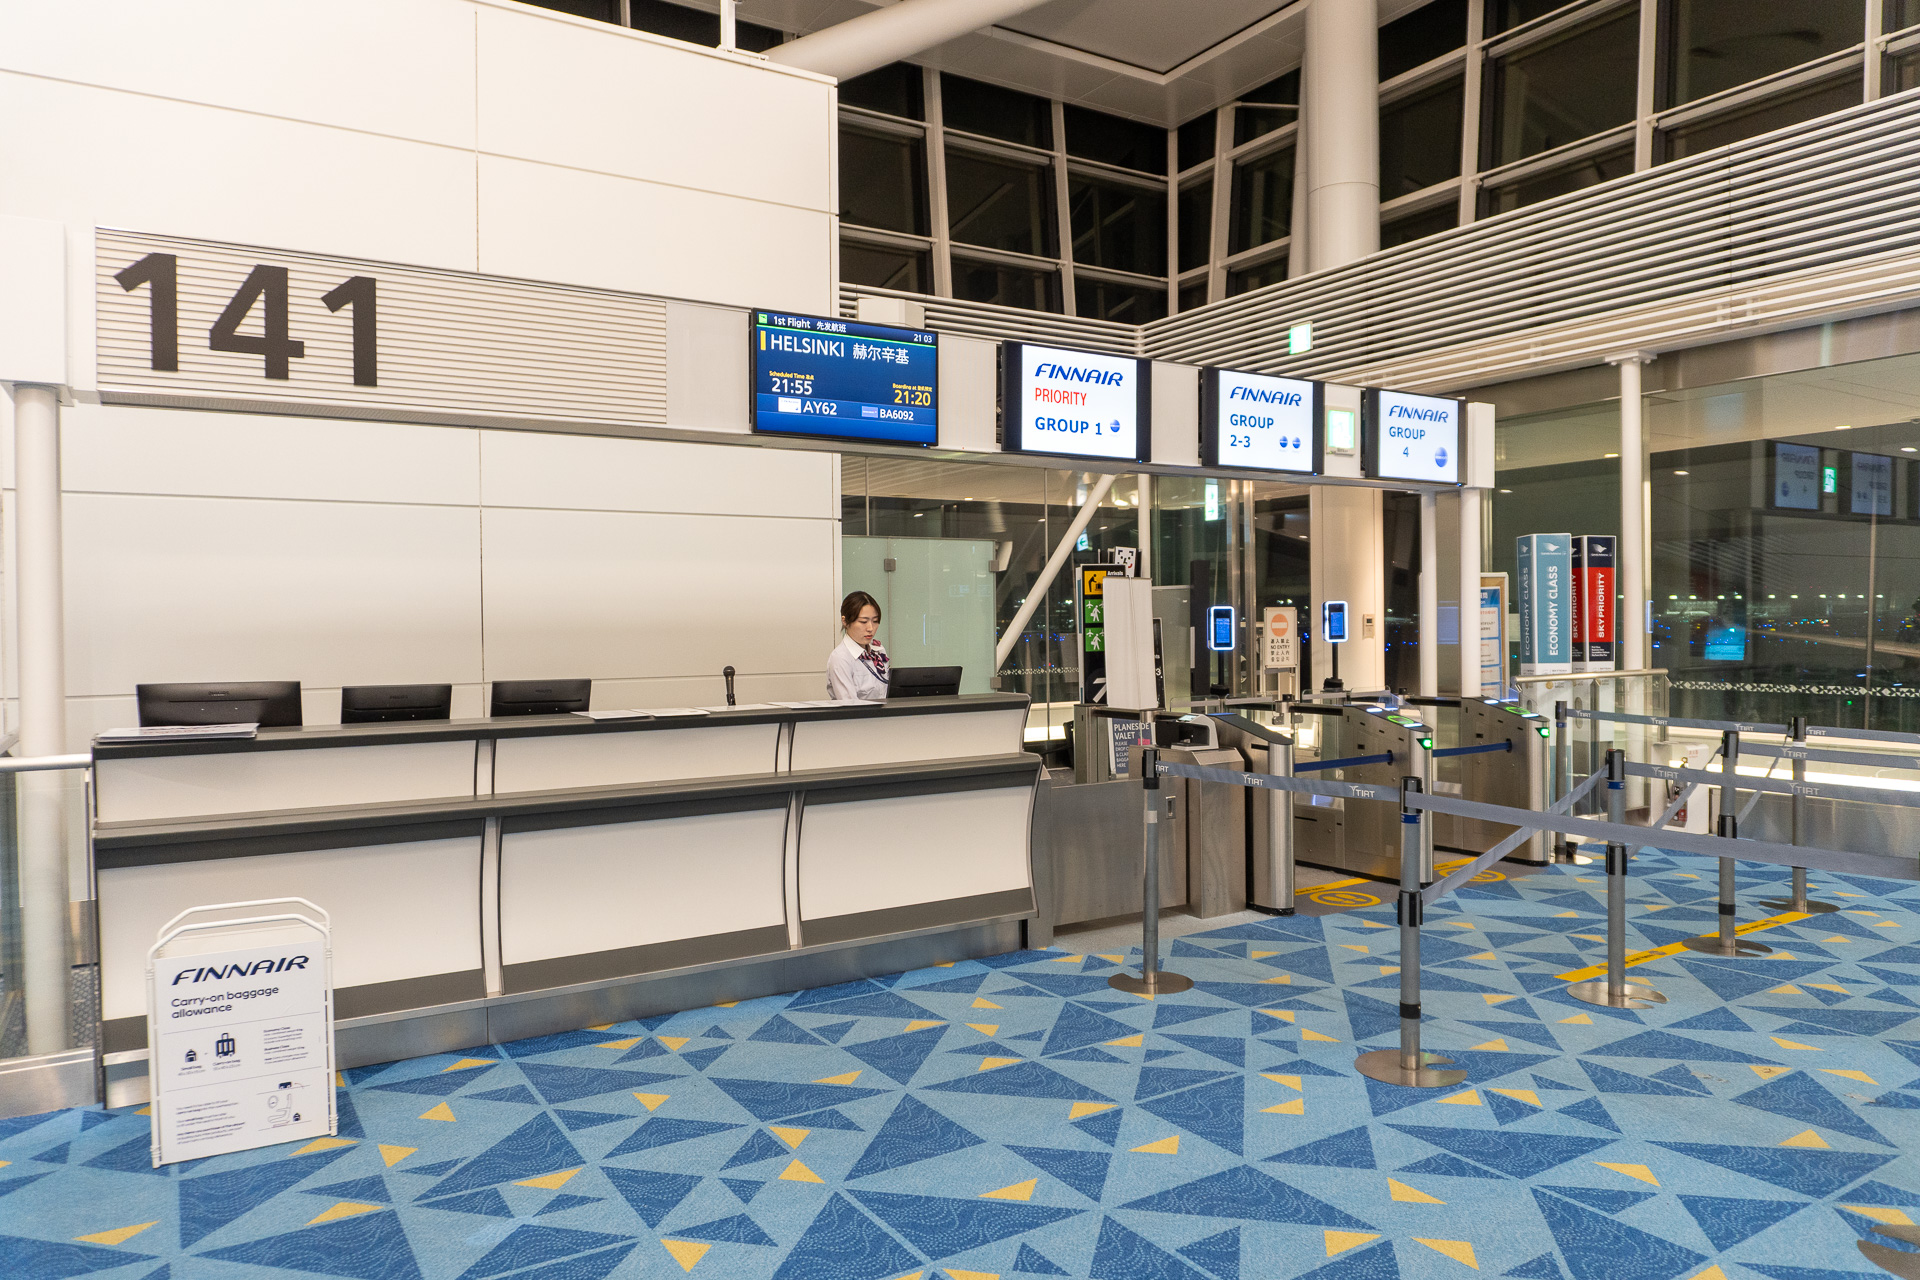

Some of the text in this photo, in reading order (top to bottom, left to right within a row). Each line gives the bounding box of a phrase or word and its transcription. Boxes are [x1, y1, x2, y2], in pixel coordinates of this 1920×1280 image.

[113, 252, 377, 388] 141
[773, 315, 811, 329] 1st Flight
[771, 334, 845, 357] HELSINKI
[913, 333, 933, 343] 21 03
[852, 342, 910, 365] 赫尔辛基
[769, 370, 793, 379] Scheduled
[1034, 363, 1124, 387] FINNAIR
[771, 377, 813, 396] 21:55
[894, 389, 932, 407] 21:20
[1034, 387, 1088, 406] PRIORITY
[1230, 386, 1302, 407] FINNAIR
[802, 400, 838, 416] AY62
[880, 408, 914, 421] BA6092
[1388, 405, 1449, 424] FINNAIR
[1034, 416, 1102, 436] GROUP 1
[1230, 413, 1274, 430] GROUP
[1230, 434, 1251, 448] 2-3
[1388, 426, 1426, 440] GROUP
[1402, 446, 1410, 458] 4
[1548, 566, 1559, 656] ECONOMY CLASS
[1114, 732, 1135, 740] VALET
[171, 955, 310, 986] FINNAIR
[171, 986, 280, 1008] Carry-on baggage
[171, 1004, 232, 1019] allowance
